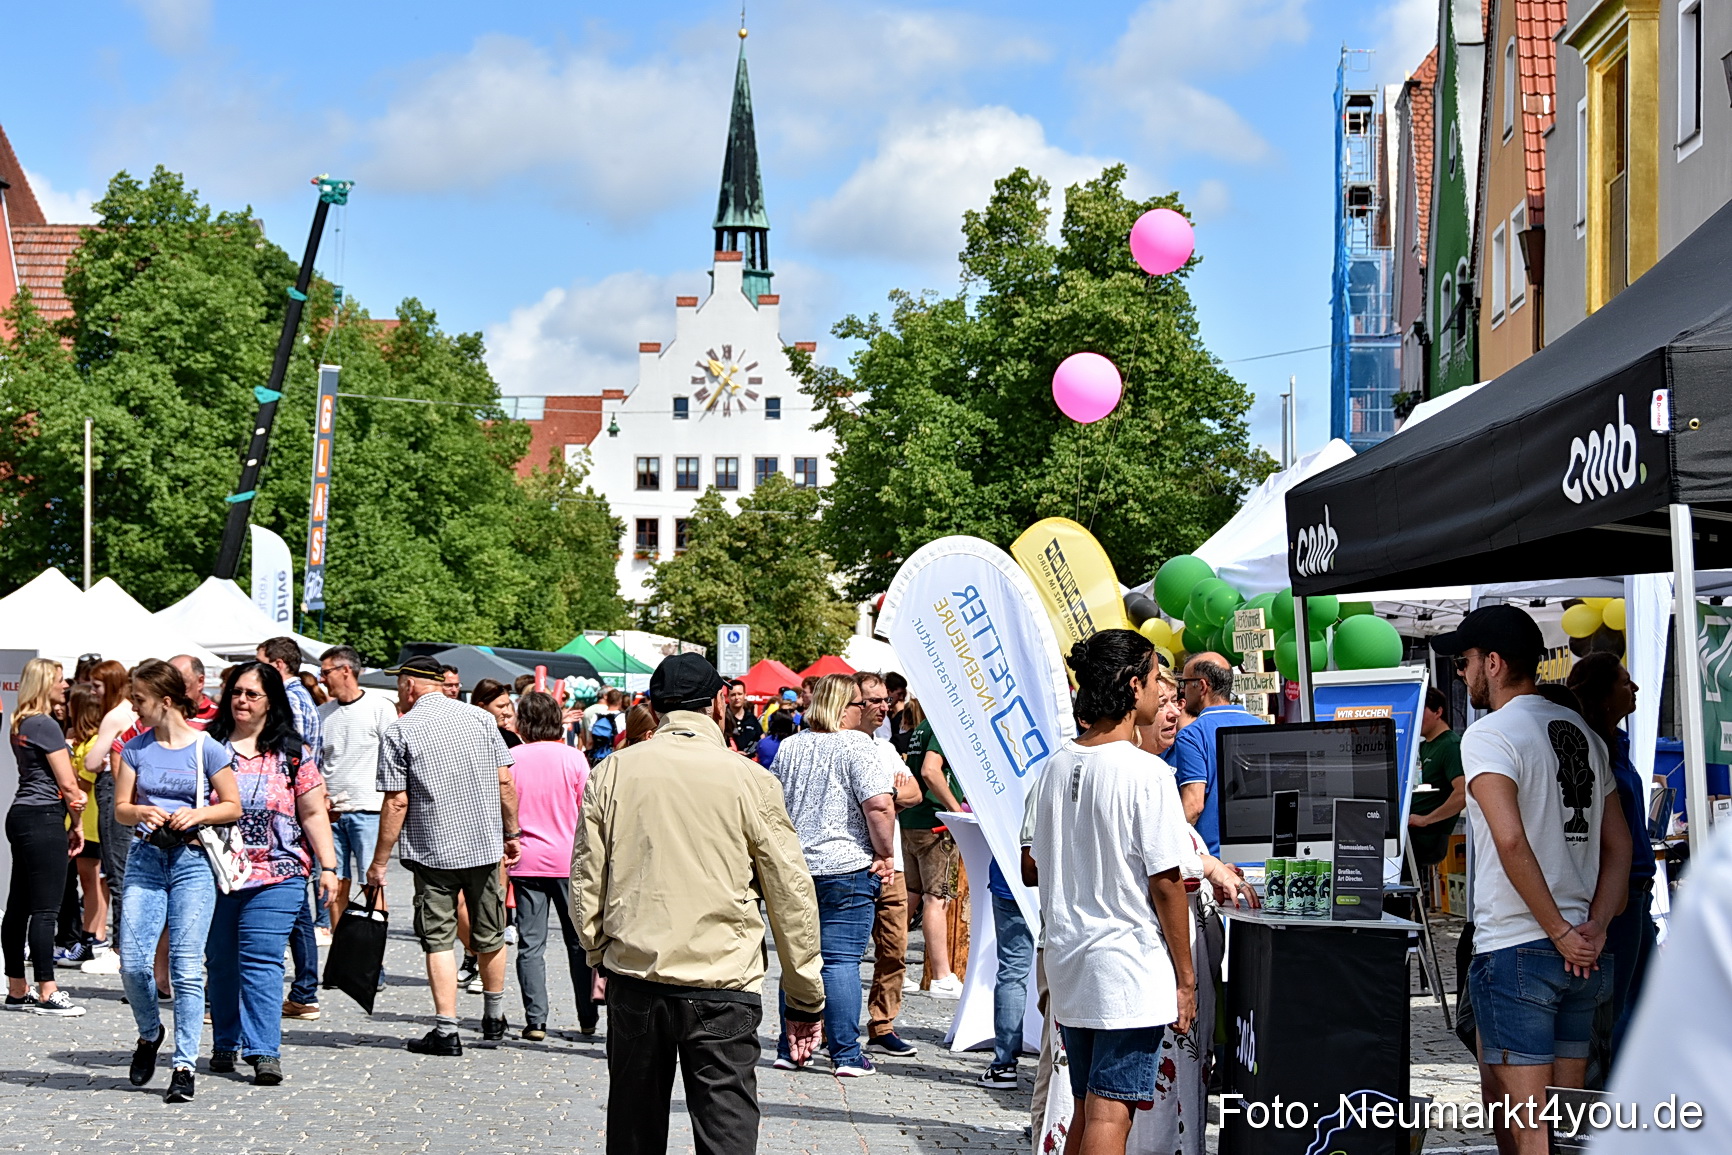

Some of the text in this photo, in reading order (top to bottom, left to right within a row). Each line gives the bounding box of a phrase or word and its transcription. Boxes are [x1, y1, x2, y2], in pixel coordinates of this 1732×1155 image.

[311, 397, 332, 563] GLAS
[1235, 632, 1266, 651] monteur
[1337, 708, 1389, 718] WIR SUCHEN
[158, 771, 197, 790] happy
